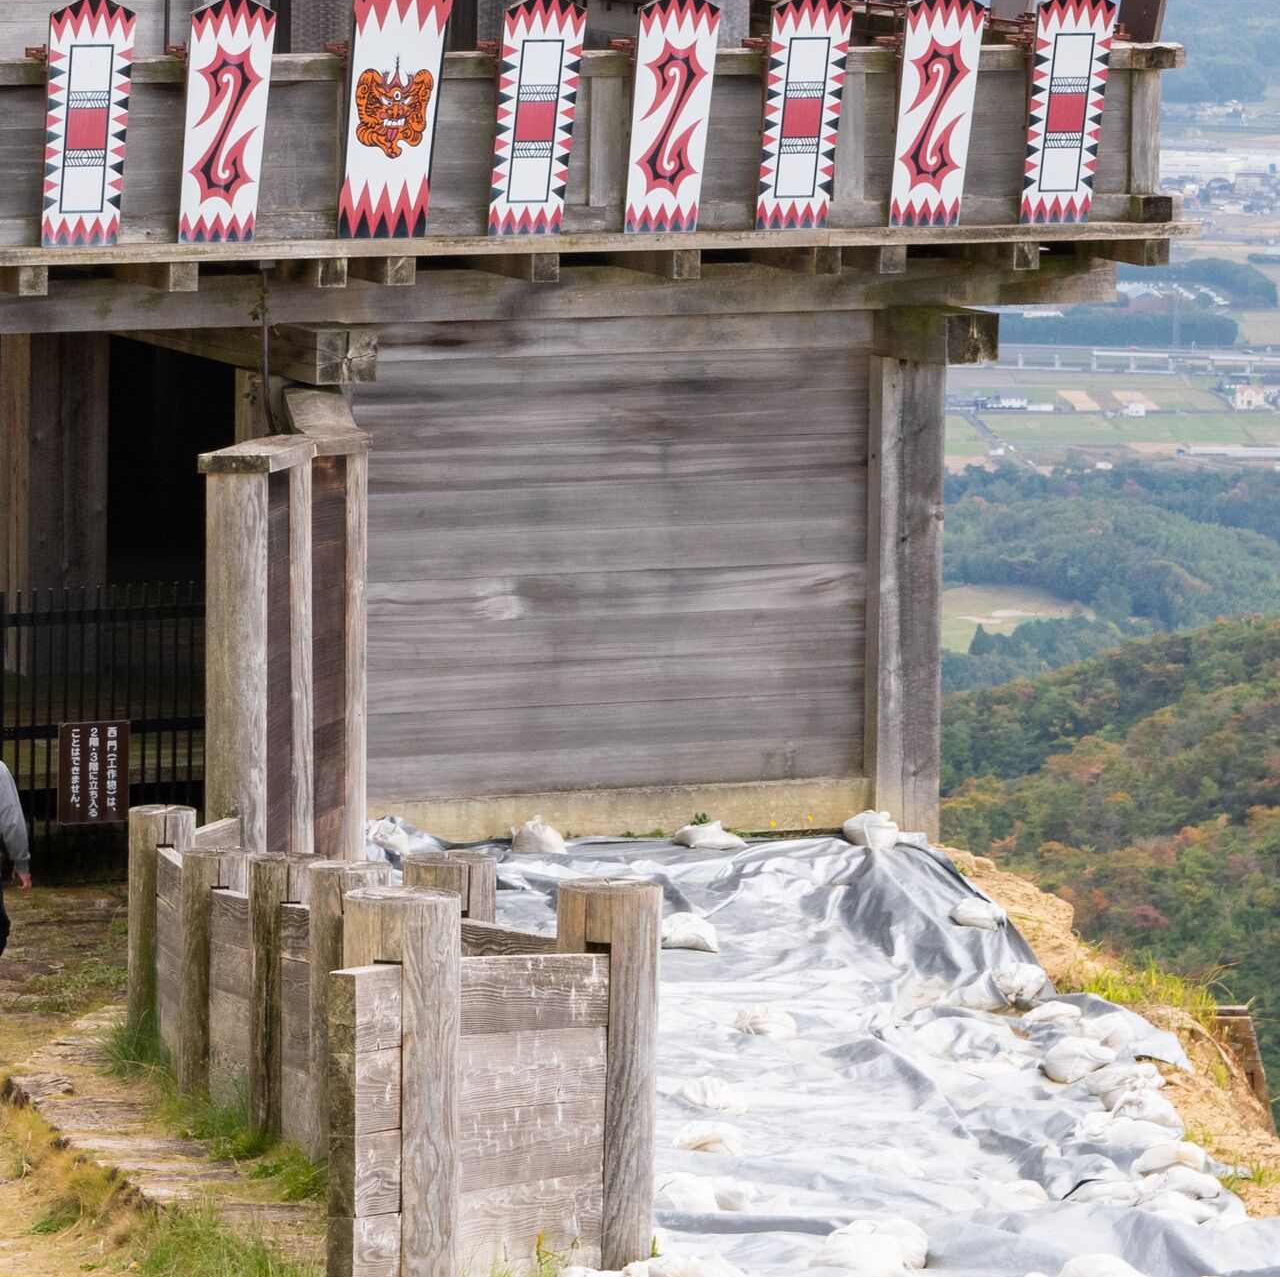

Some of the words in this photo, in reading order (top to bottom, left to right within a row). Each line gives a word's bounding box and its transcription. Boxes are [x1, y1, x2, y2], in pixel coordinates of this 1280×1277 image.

[70, 728, 81, 808] ことはできません。
[88, 727, 99, 818] 2階・3階に立ち入る
